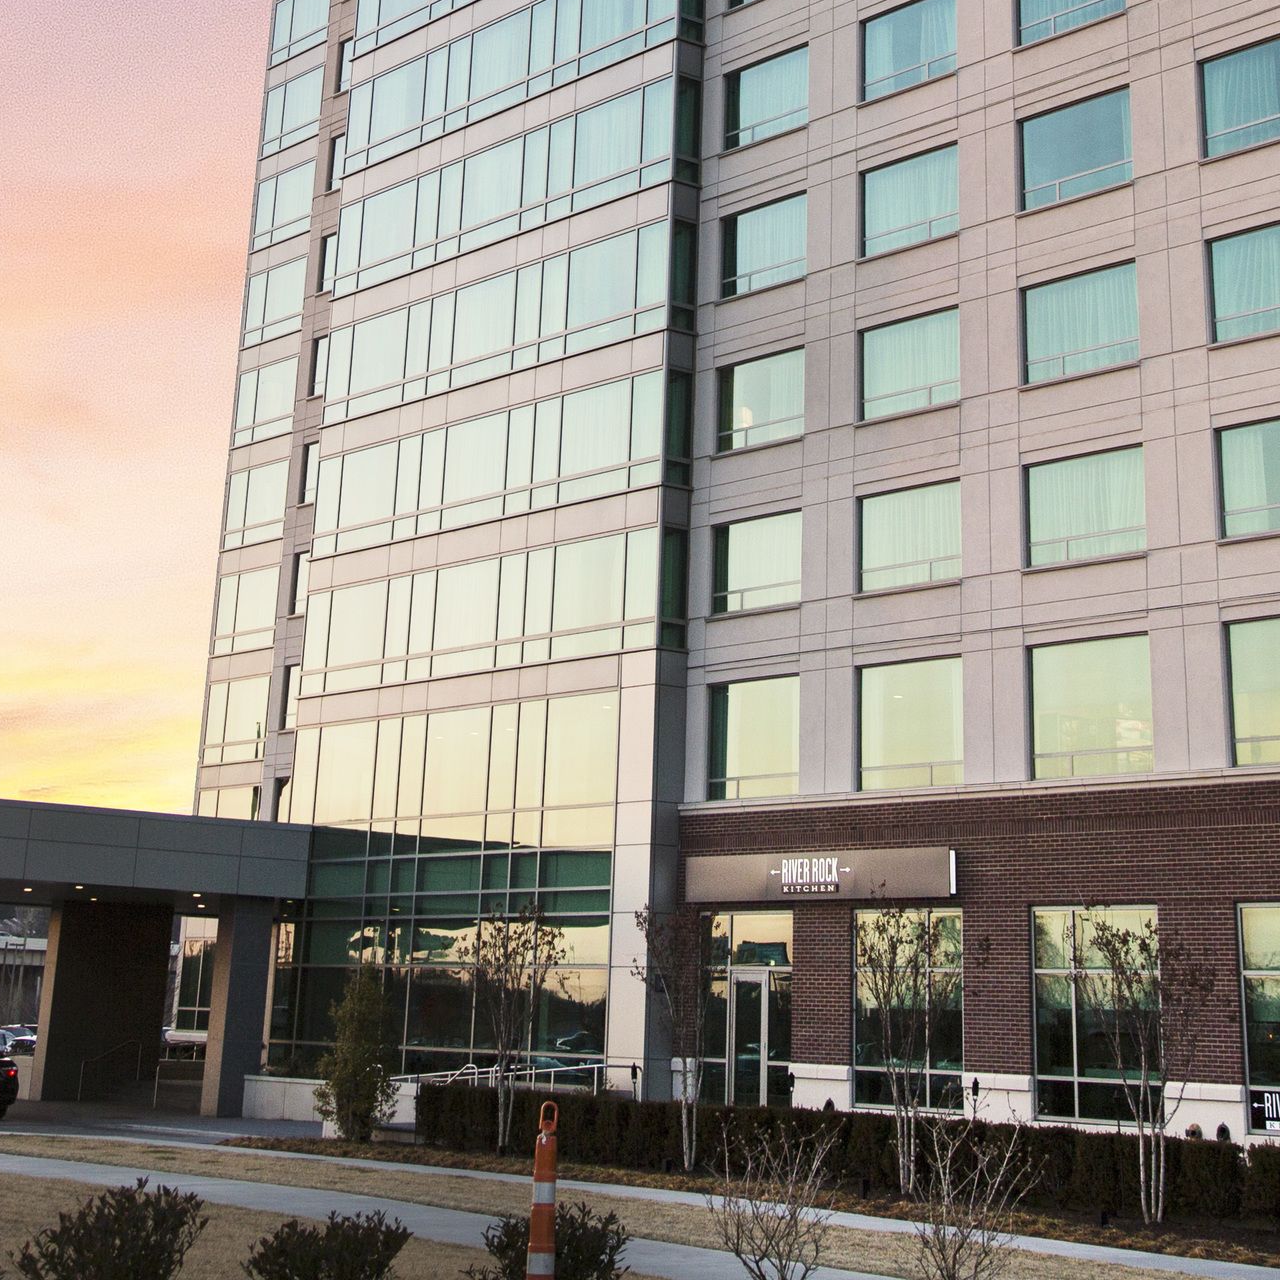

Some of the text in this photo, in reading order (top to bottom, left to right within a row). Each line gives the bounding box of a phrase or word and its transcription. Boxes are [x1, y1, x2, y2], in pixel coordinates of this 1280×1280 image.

[781, 858, 839, 883] RIVER ROCK
[783, 885, 835, 893] KITCHEN
